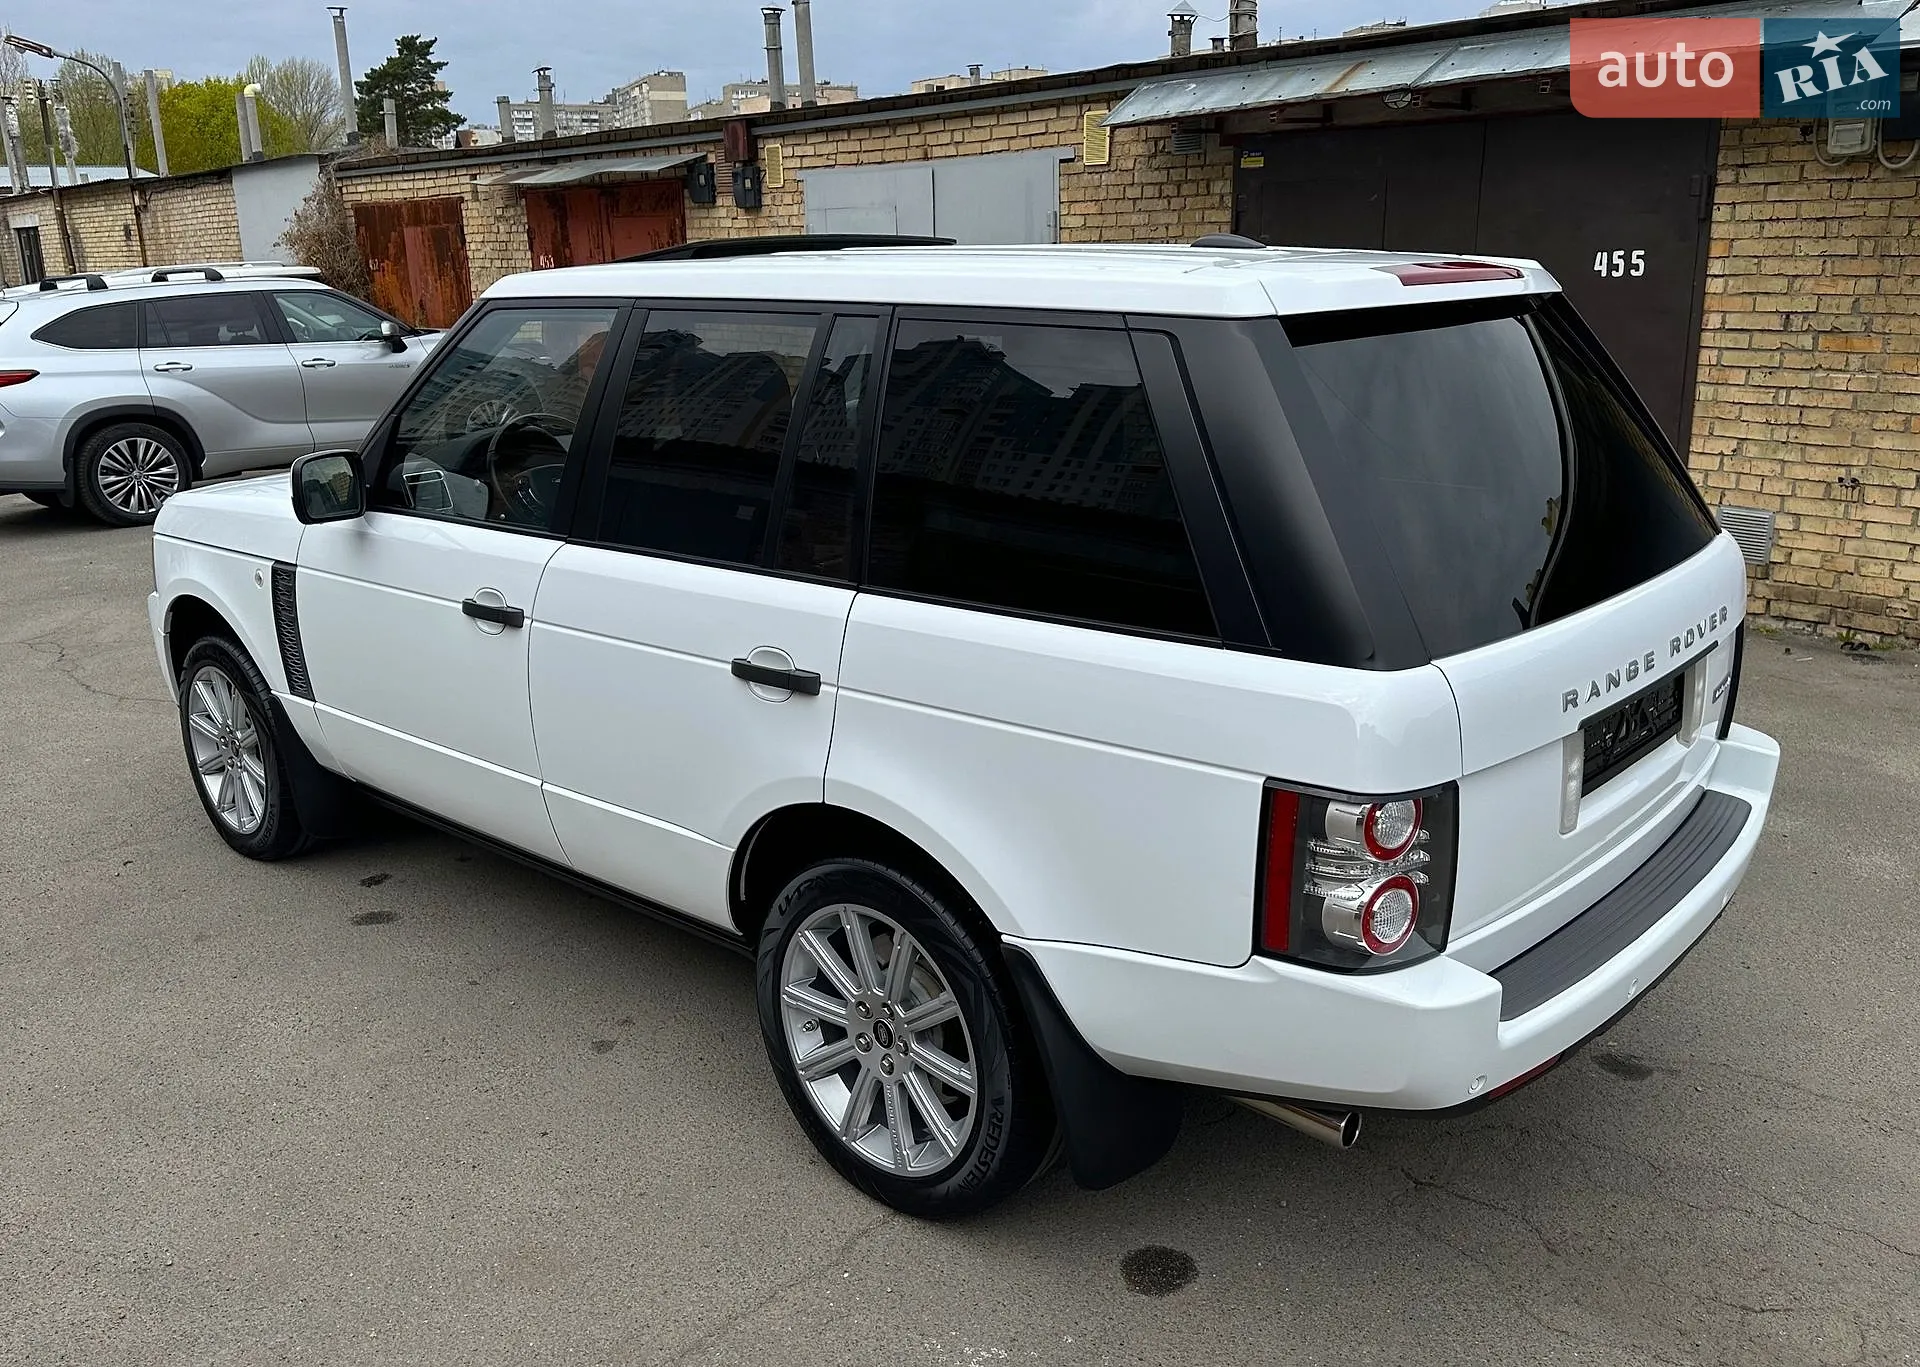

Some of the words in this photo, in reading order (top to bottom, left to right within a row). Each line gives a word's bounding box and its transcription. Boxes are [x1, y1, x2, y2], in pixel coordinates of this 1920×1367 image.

[1594, 250, 1645, 277] 455
[1562, 650, 1655, 712] RANGE
[1669, 605, 1728, 657] ROVER
